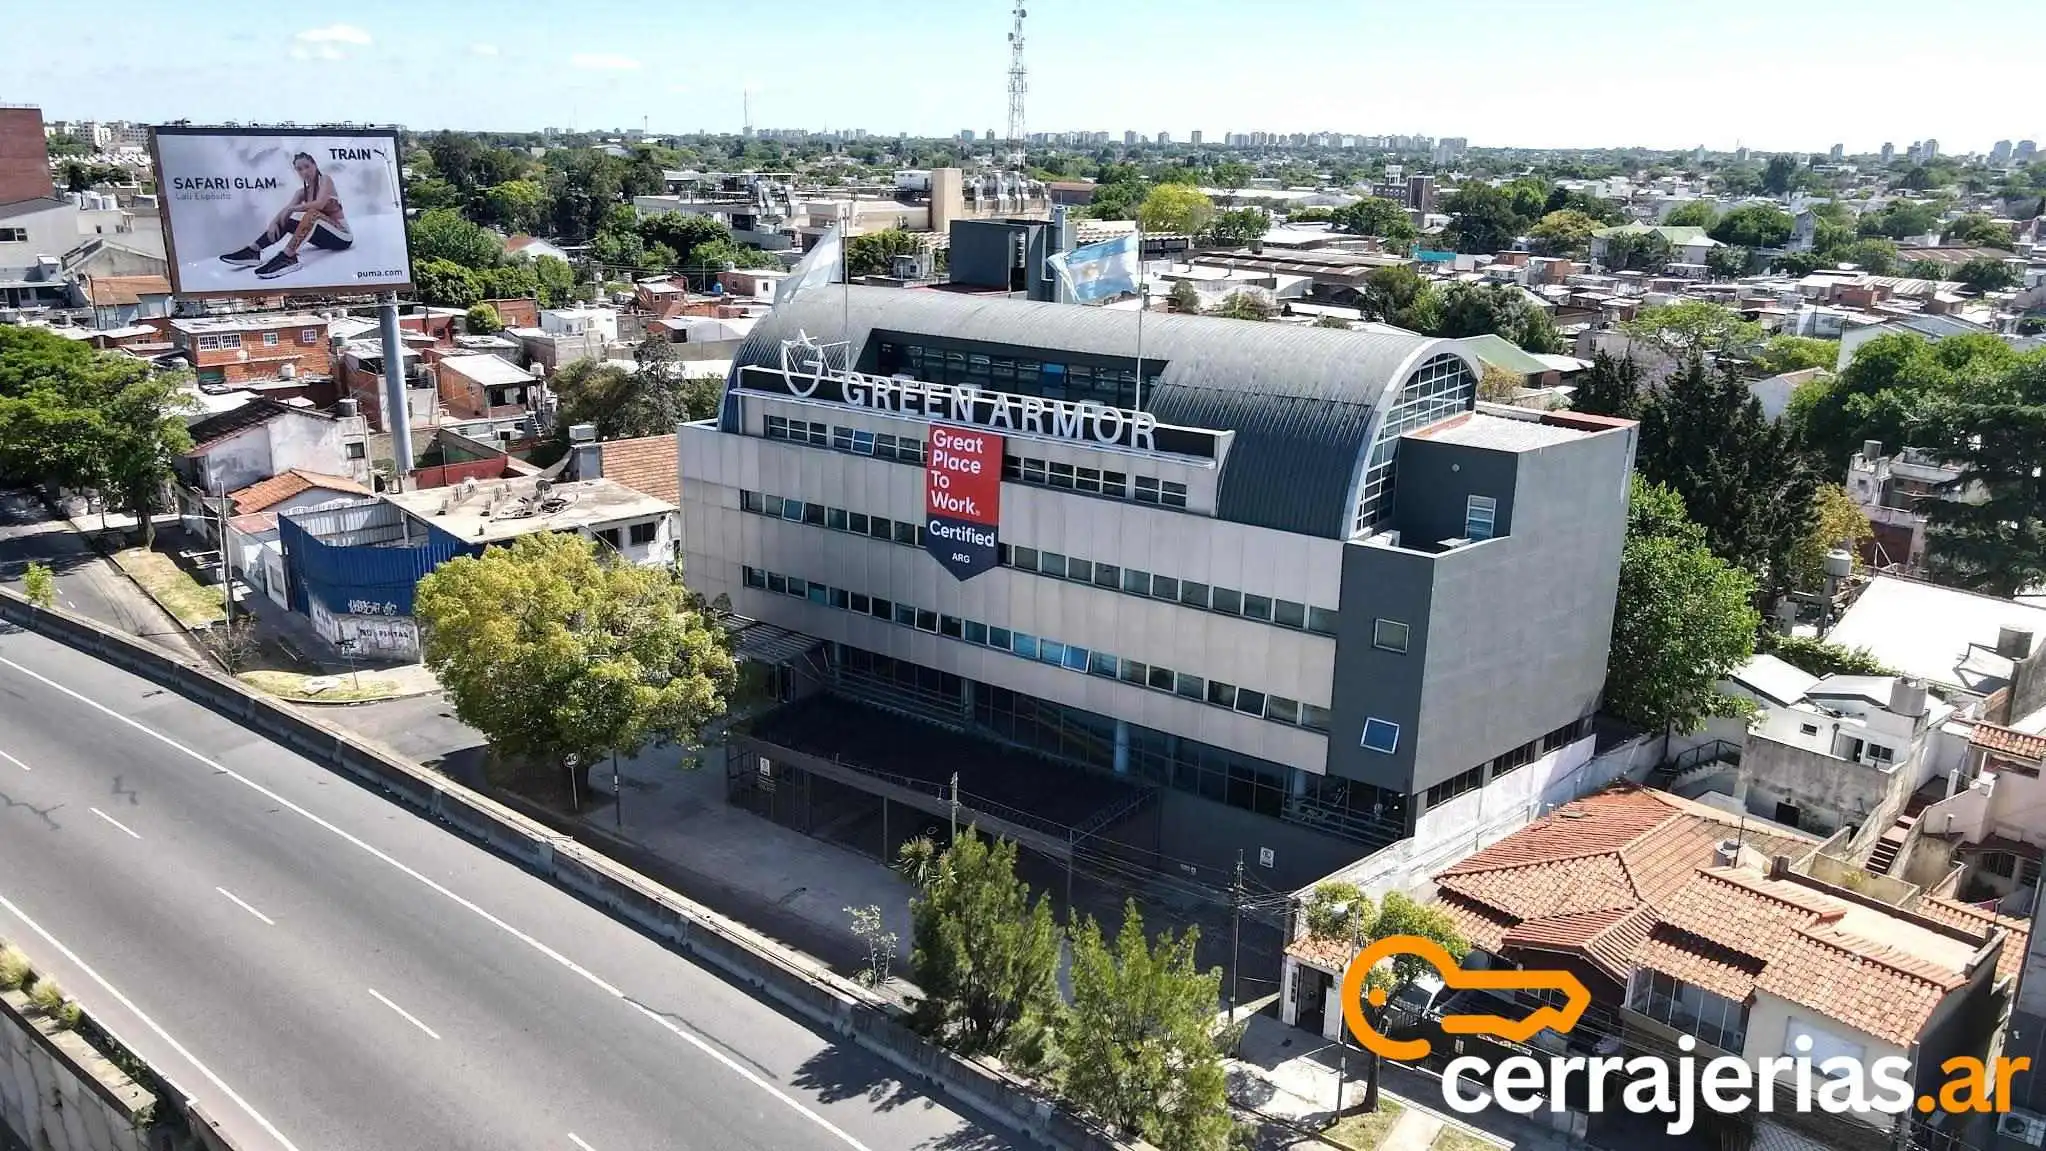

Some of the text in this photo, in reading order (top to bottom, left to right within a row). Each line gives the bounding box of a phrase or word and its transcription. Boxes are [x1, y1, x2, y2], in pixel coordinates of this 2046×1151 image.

[328, 148, 372, 161] TRAIN
[174, 177, 277, 190] SAFARI GLAM
[357, 269, 403, 279] puma.com
[841, 371, 1157, 450] GREEN ARMOR
[933, 429, 984, 454] Great
[932, 450, 982, 475] Place
[930, 470, 950, 489] To
[929, 520, 996, 548] Certified
[952, 552, 971, 564] ARG
